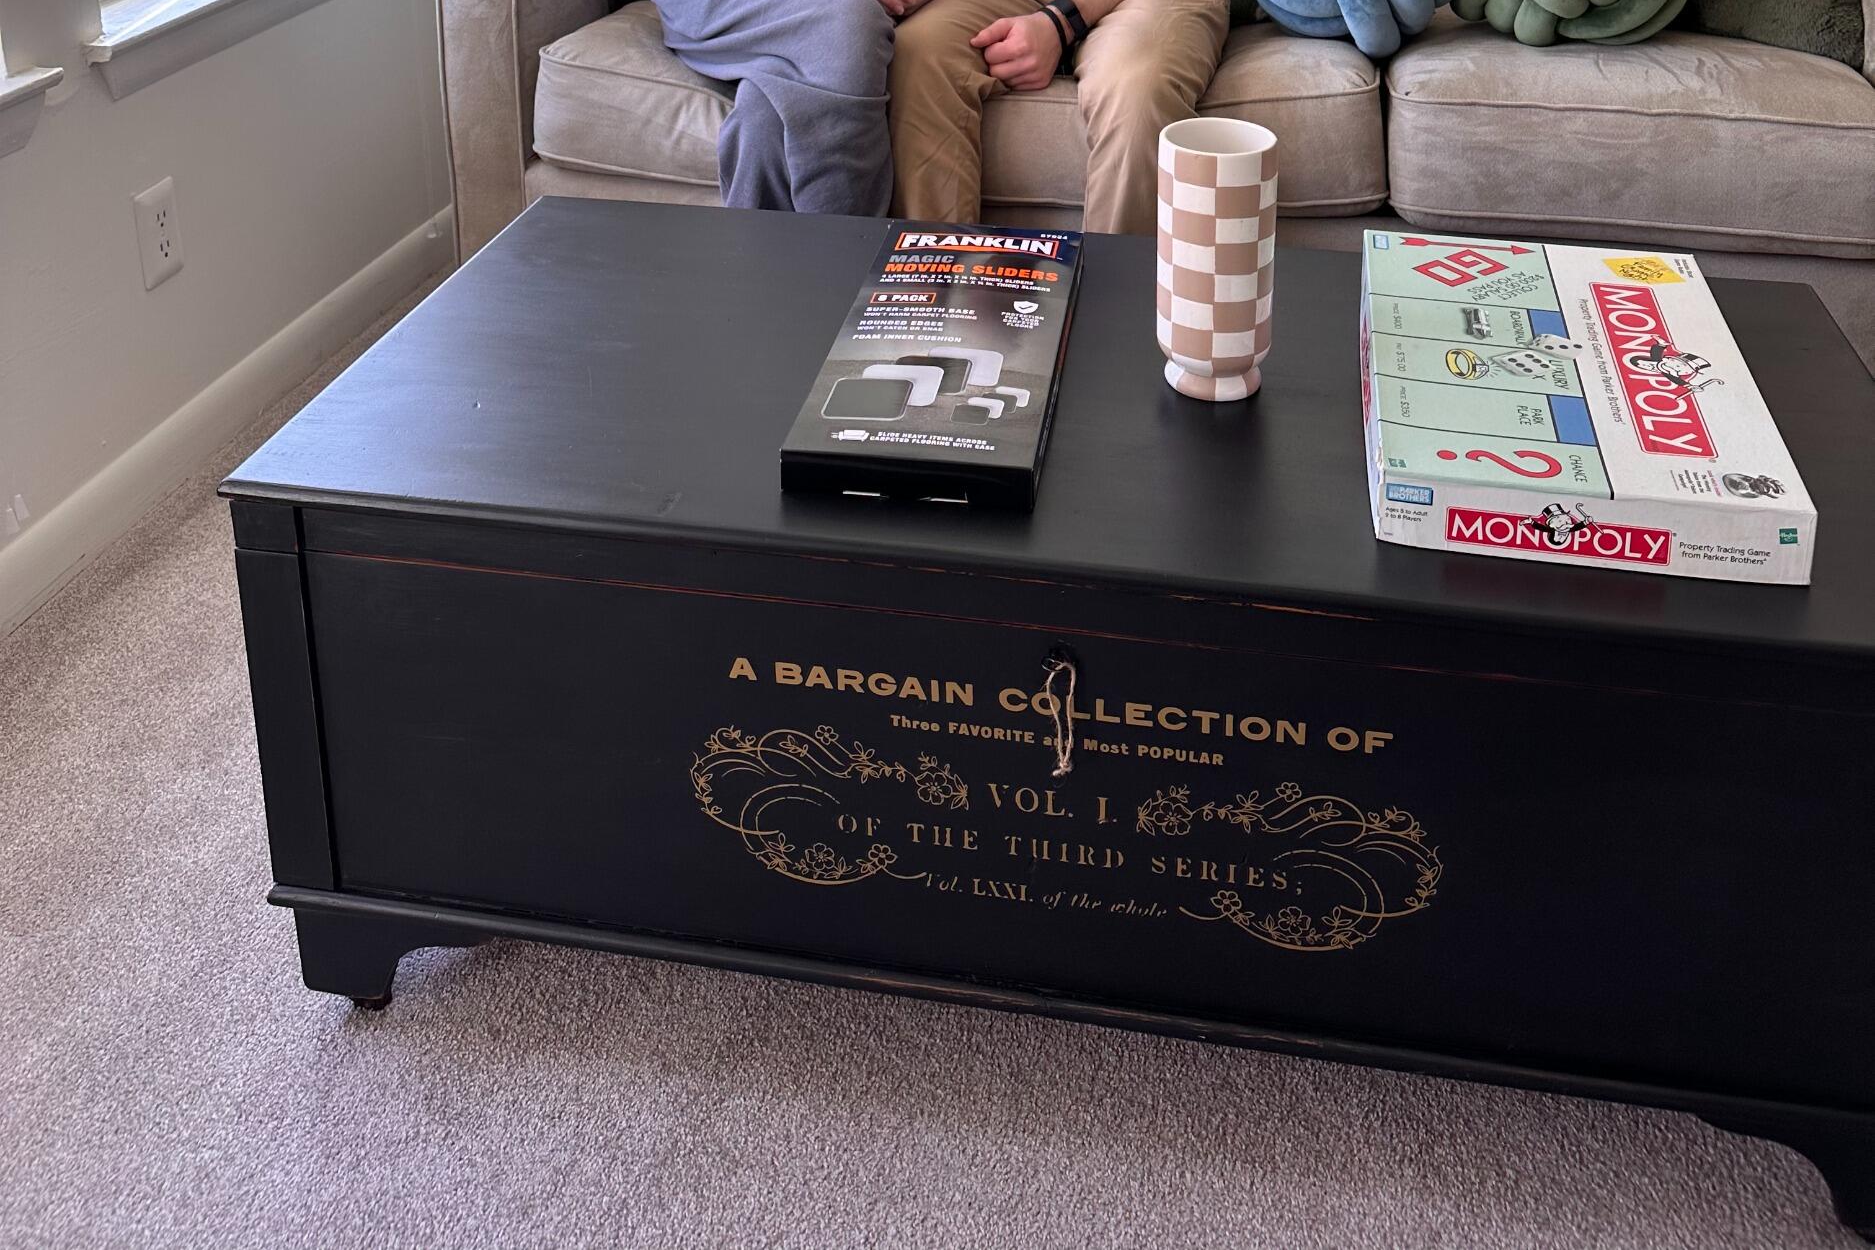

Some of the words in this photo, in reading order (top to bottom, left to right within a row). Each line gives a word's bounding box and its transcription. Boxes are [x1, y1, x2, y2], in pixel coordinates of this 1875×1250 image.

[901, 234, 1053, 255] FRANKLIN
[889, 254, 954, 263] MAGIC
[1412, 249, 1509, 287] GO
[884, 263, 965, 273] MOVING
[972, 265, 1059, 282] SLIDERS
[878, 294, 888, 302] 8
[866, 306, 946, 314] SUPER-SMOOTH
[941, 313, 978, 321] FLOORING
[917, 334, 962, 343] CUSHION
[1586, 322, 1599, 342] Trading
[1592, 342, 1604, 359] Game
[1597, 358, 1609, 376] from
[1600, 286, 1702, 453] MONOPOLY
[1602, 375, 1615, 396] Parker
[1517, 406, 1531, 426] PLACE
[1531, 408, 1544, 426] PARK
[870, 435, 910, 443] CARPETED
[911, 438, 951, 447] FLOORING
[974, 443, 996, 451] EASE
[929, 434, 954, 442] ITEMS
[955, 437, 988, 445] ACROSS
[1568, 454, 1587, 484] CHANCE
[1403, 514, 1422, 522] Players
[1451, 512, 1666, 559] MONOPOLY
[1680, 541, 1714, 553] Property
[1717, 545, 1745, 556] Trading
[1747, 548, 1771, 557] Game
[1681, 551, 1701, 559] from
[1703, 553, 1728, 562] Parker
[729, 657, 757, 681] A
[774, 661, 974, 706] BARGAIN
[998, 687, 1306, 745] COLLECTION
[1326, 726, 1394, 754] OF
[890, 714, 940, 732] Three
[948, 721, 1034, 744] FAVORITE
[1083, 738, 1129, 755] Most
[1137, 744, 1224, 766] POPULAR
[988, 783, 1074, 818] VOL.
[1096, 796, 1118, 825] I.
[838, 813, 881, 837] OF
[906, 823, 978, 850] THE
[1004, 836, 1124, 869] THIRD
[926, 873, 963, 893] Vol.
[1042, 890, 1067, 910] of
[1071, 893, 1101, 910] the
[1110, 899, 1168, 918] whole
